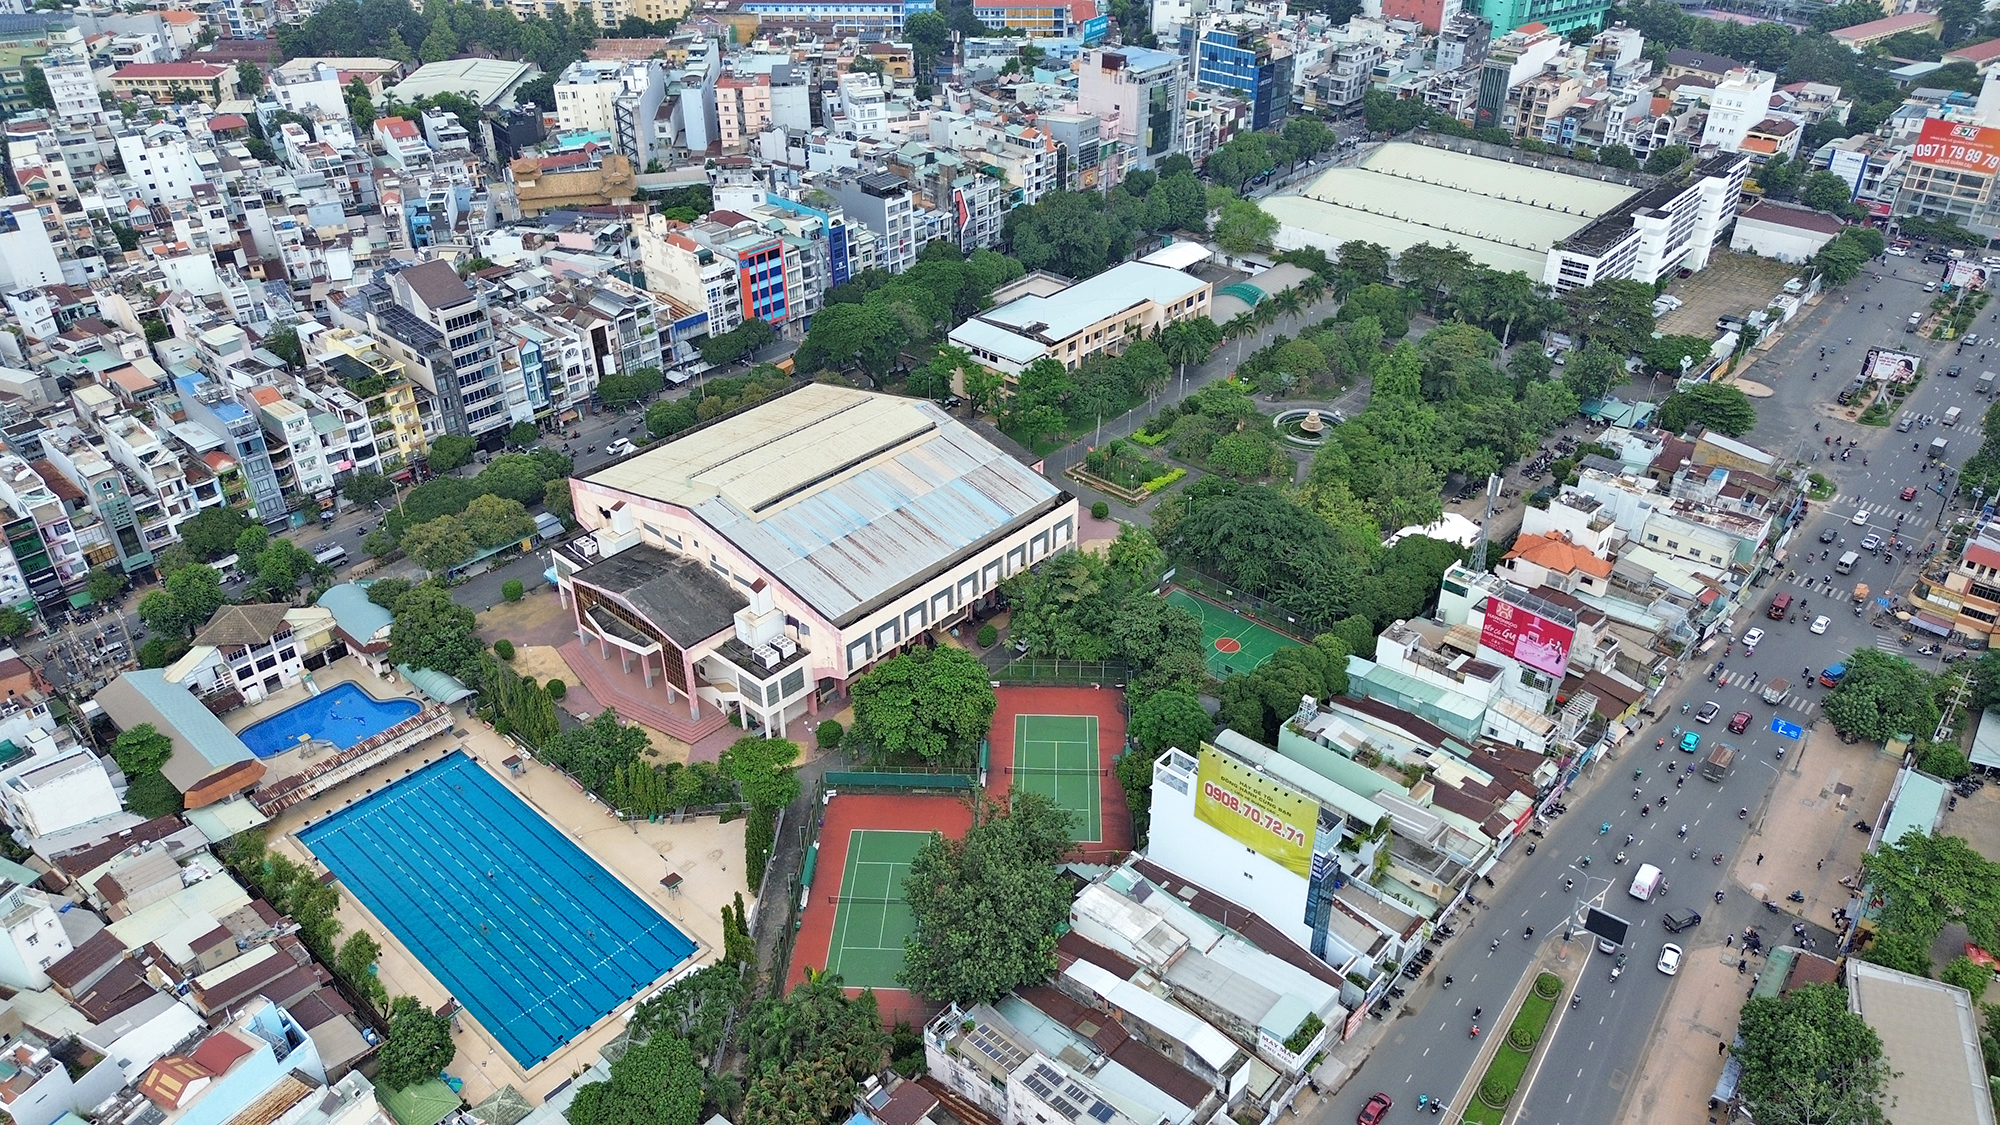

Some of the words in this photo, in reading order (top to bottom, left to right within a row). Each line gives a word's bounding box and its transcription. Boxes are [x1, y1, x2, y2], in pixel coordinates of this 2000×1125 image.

[1953, 127, 1978, 138] SJK
[1917, 144, 1946, 157] 0971
[1949, 145, 1965, 160] 79
[1965, 148, 1982, 164] 89
[1982, 153, 2000, 169] 79
[1240, 784, 1257, 800] HÀNH
[1204, 780, 1305, 848] 0908.70.72.71
